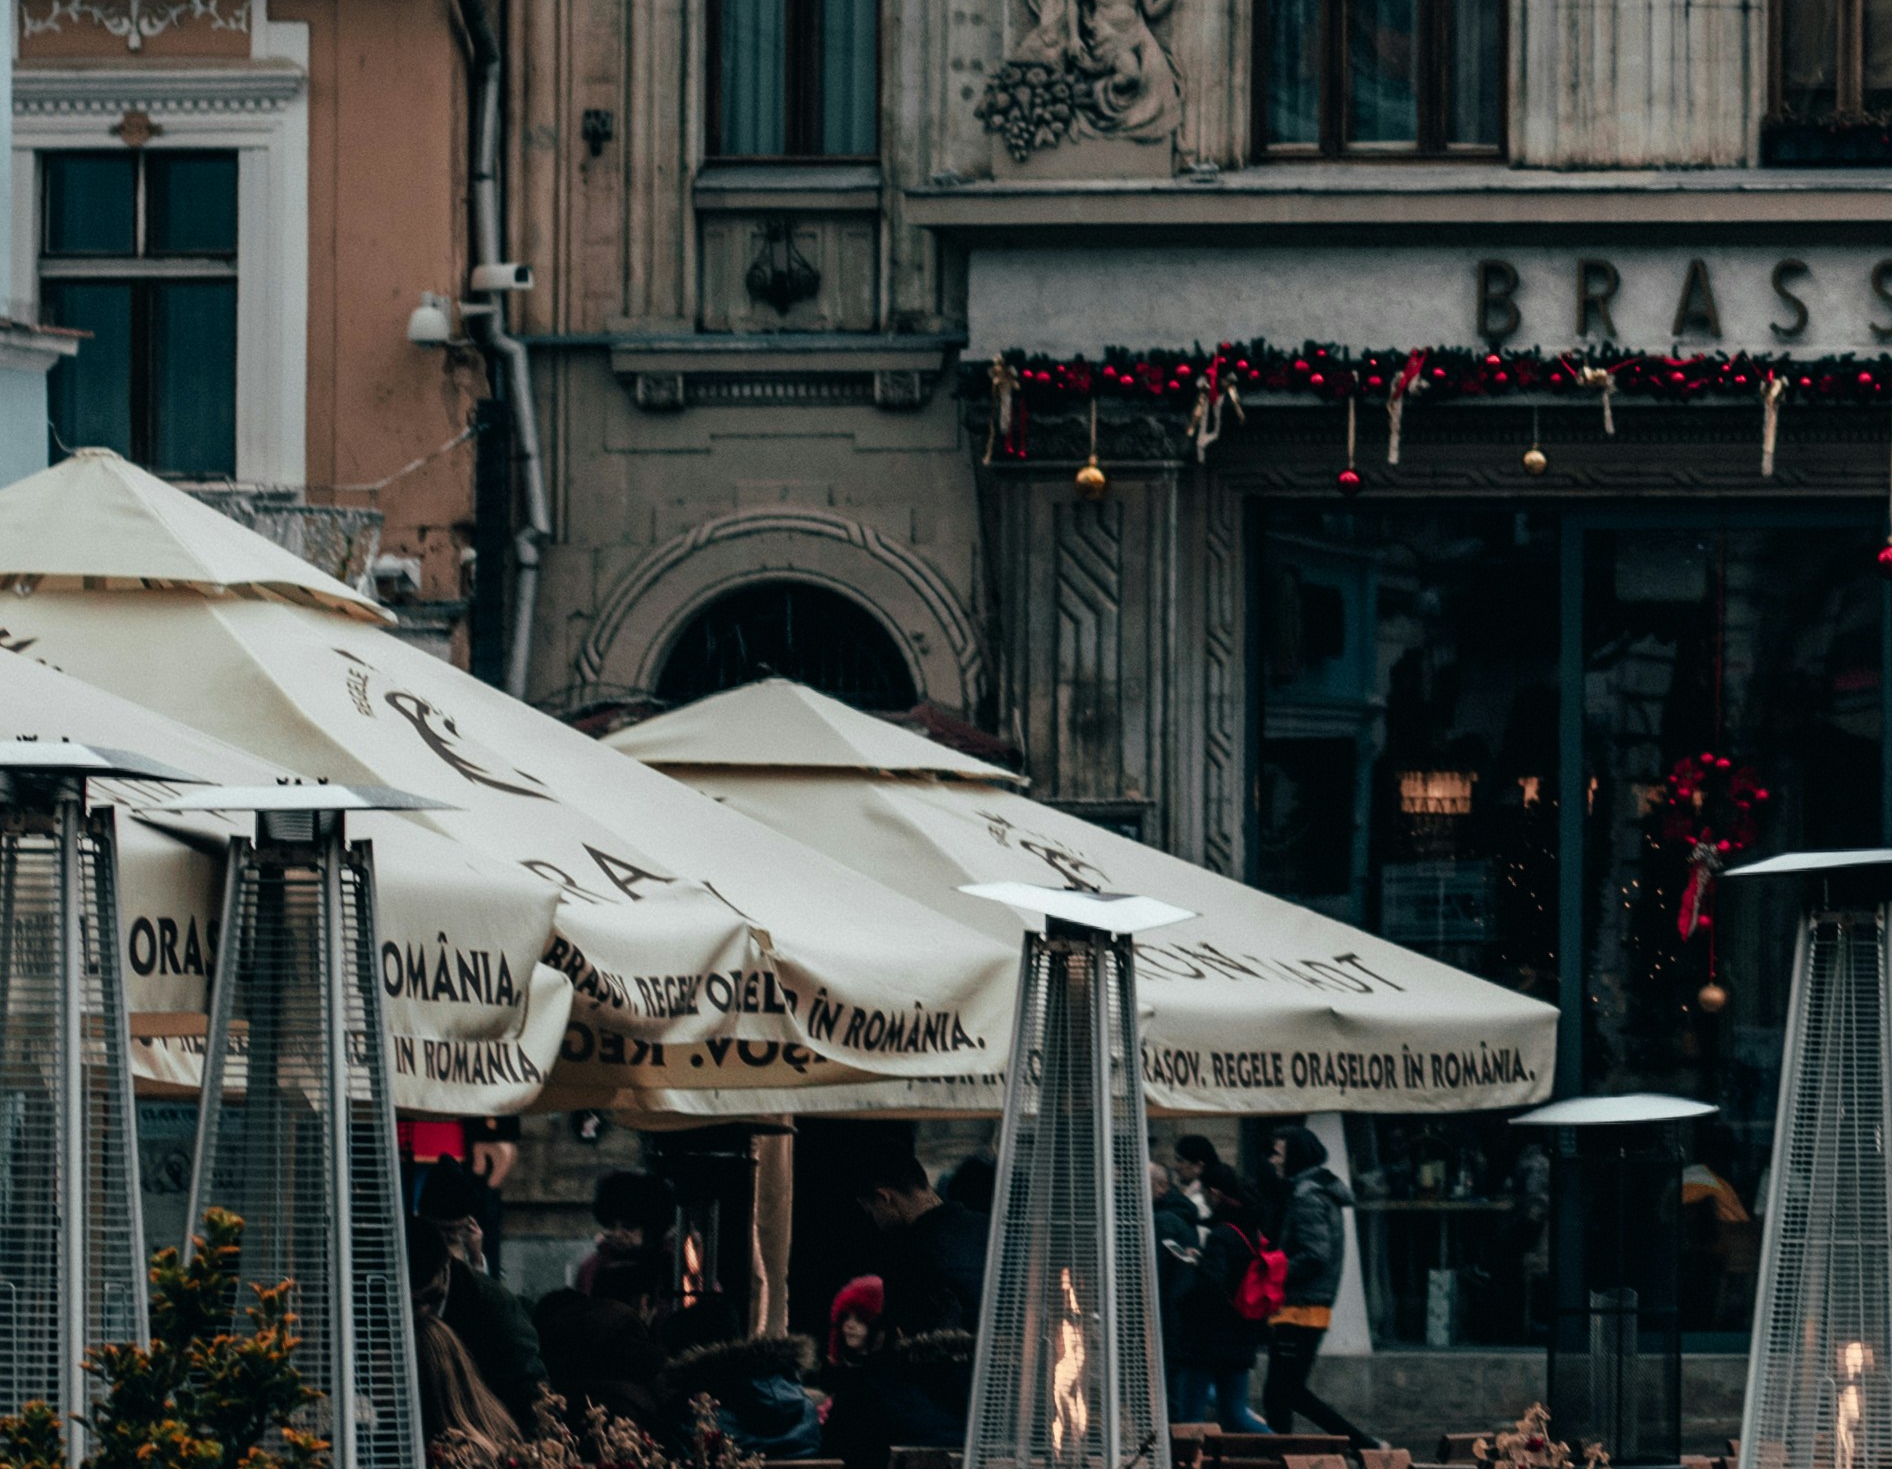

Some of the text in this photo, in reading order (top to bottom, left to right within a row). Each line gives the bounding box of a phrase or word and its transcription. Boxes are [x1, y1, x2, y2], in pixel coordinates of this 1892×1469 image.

[843, 1000, 986, 1054] ROMÂNIA.
[1210, 1050, 1284, 1088] REGELE
[1291, 1050, 1398, 1096] ORAȘELOR
[1401, 1043, 1425, 1089] ÎN
[1430, 1040, 1536, 1089] ROMÂNIA.
